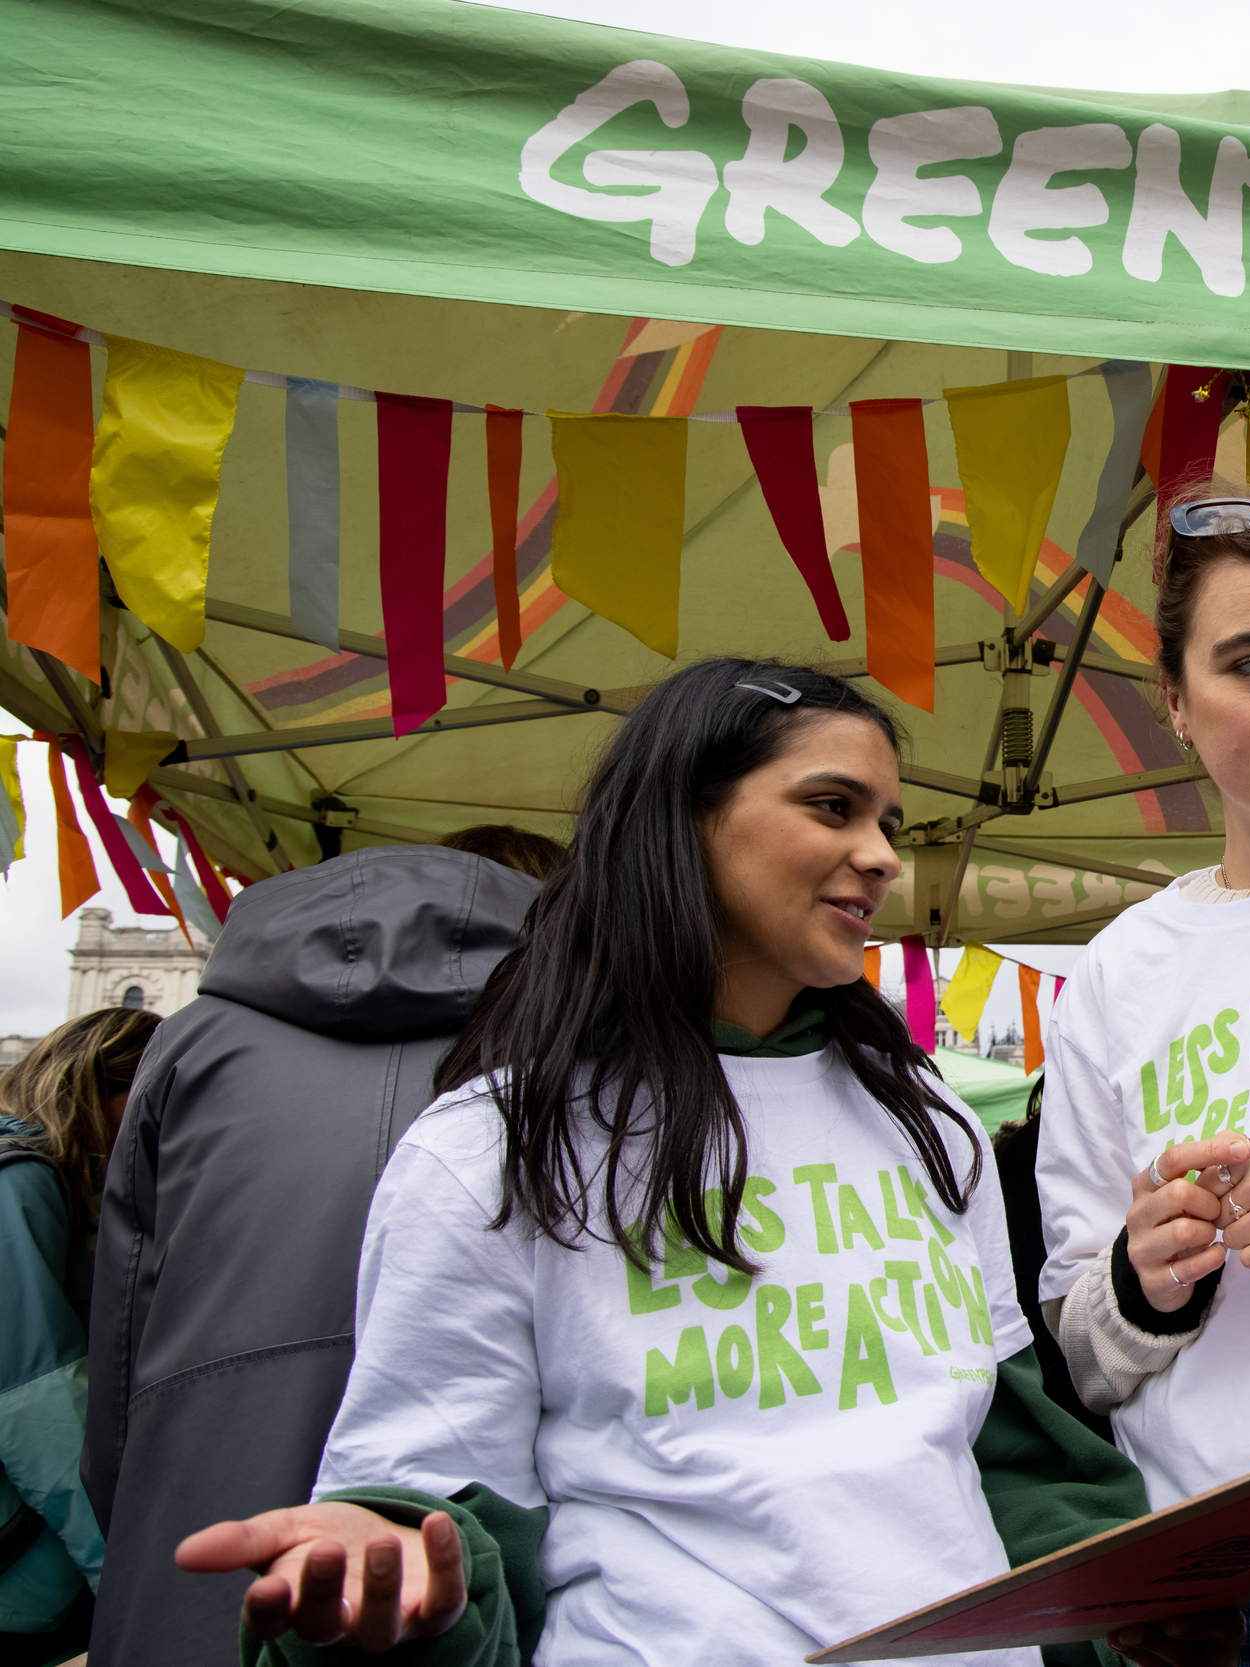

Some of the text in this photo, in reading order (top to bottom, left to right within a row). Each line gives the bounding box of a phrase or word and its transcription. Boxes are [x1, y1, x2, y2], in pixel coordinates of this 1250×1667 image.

[1140, 1008, 1241, 1135] LESS
[793, 1162, 956, 1254] TALK
[645, 1236, 994, 1417] MORE ACTION
